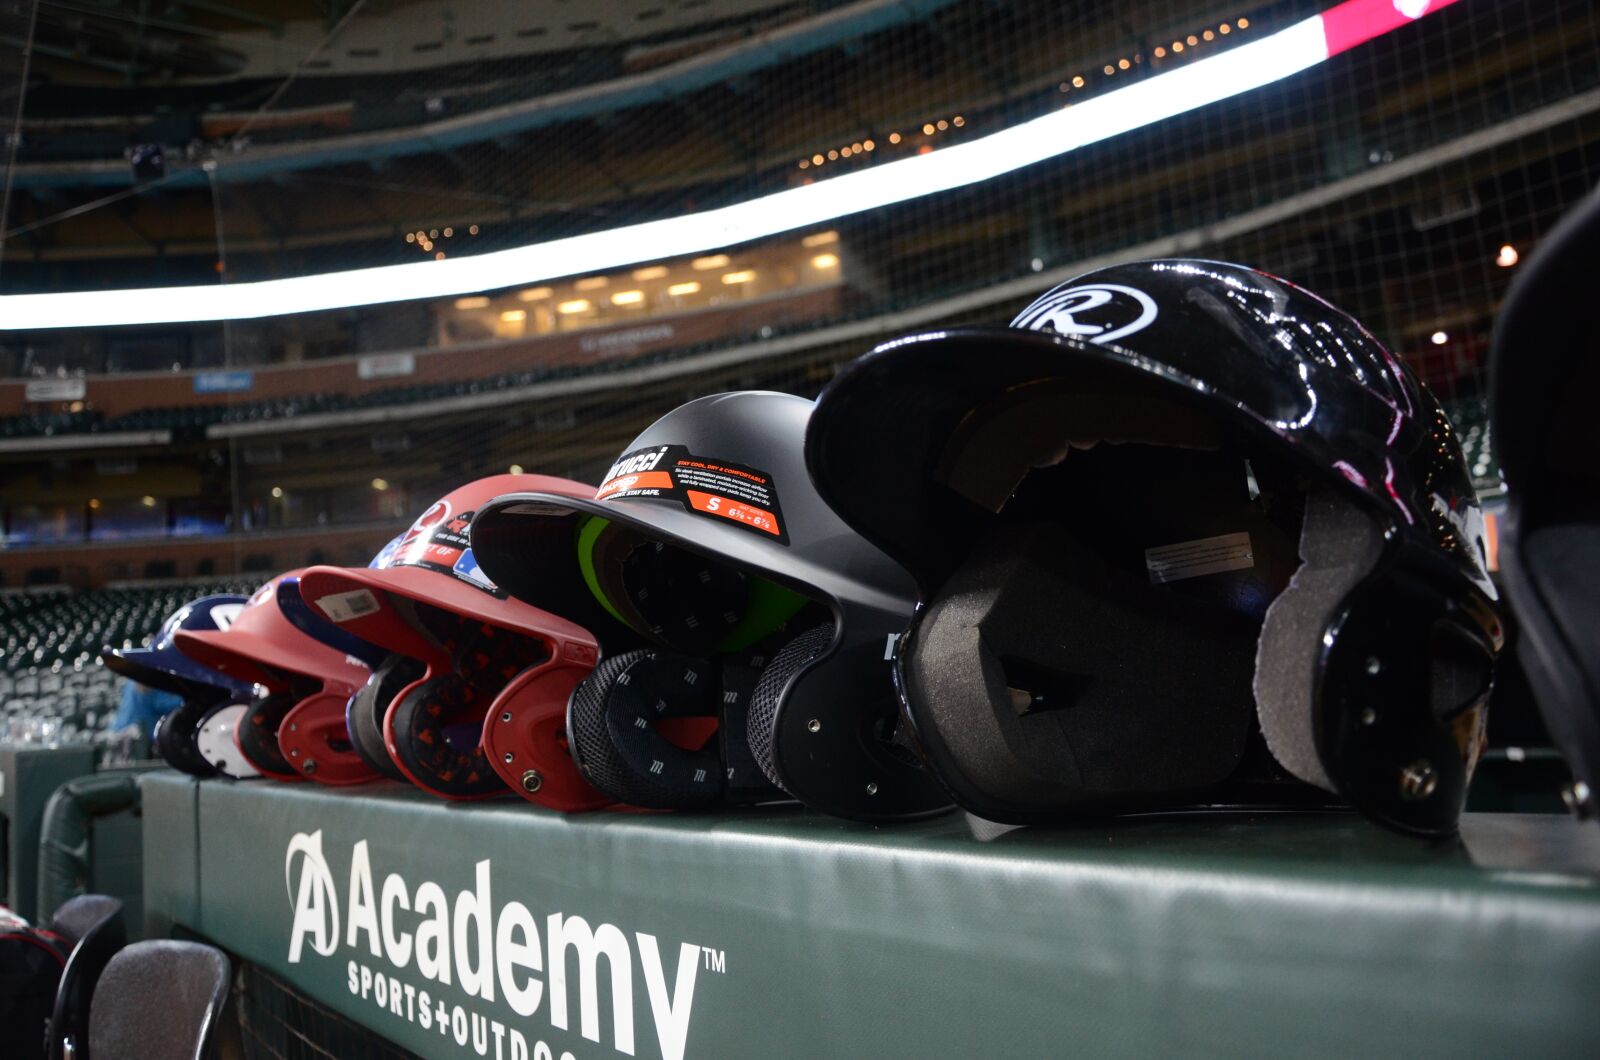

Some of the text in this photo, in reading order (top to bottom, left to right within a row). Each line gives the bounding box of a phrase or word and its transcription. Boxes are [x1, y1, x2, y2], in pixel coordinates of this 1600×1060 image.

[693, 470, 715, 478] ventilation
[732, 478, 751, 487] increase
[751, 483, 768, 493] airflow
[724, 468, 766, 484] COMFORTABLE
[693, 475, 716, 484] laminated,
[717, 480, 757, 496] moisture-wicking
[758, 491, 769, 499] liner
[699, 482, 720, 490] wrapped
[740, 491, 752, 499] keep
[706, 497, 721, 511] S
[436, 547, 455, 556] OF
[346, 839, 701, 1060] Academy
